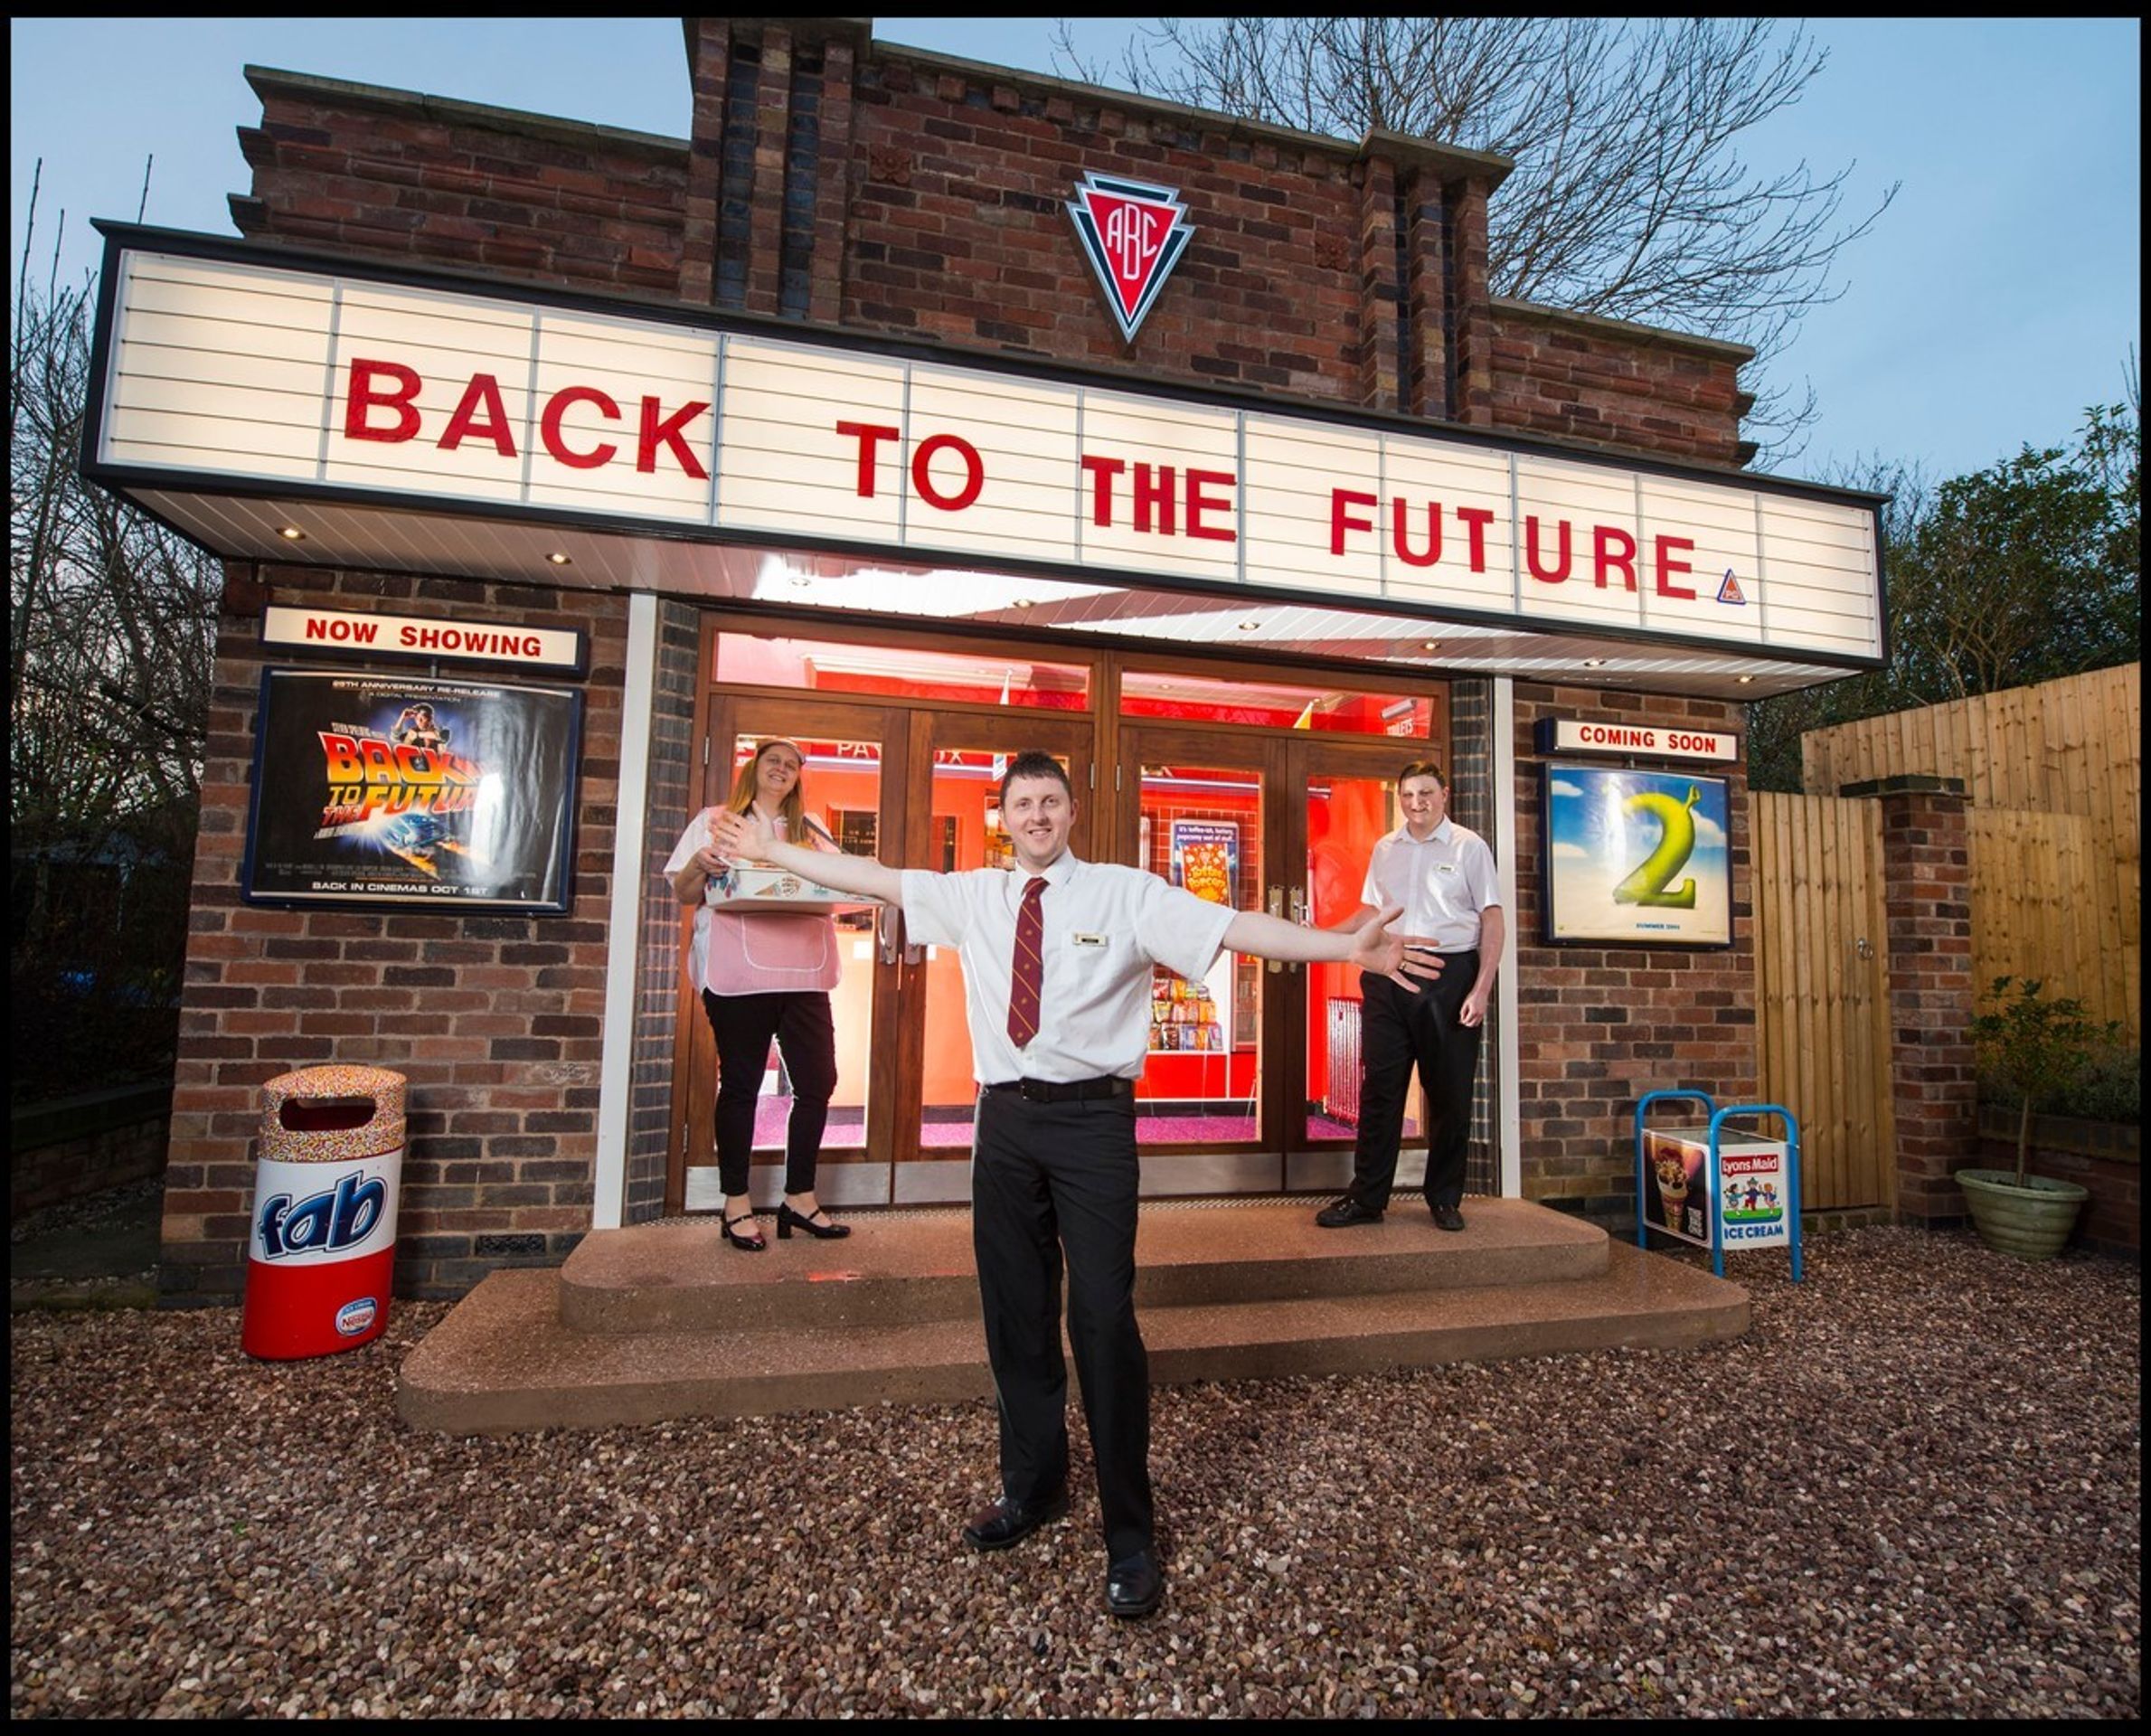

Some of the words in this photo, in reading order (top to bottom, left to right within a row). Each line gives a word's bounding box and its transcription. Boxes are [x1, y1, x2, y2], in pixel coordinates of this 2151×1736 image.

[1107, 203, 1158, 280] ABC
[344, 358, 711, 482] BACK
[835, 420, 985, 512] TO
[1081, 454, 1238, 542] THE
[1330, 488, 1696, 600] FUTURE
[306, 618, 378, 644] NOW
[400, 626, 542, 657] SHOWING
[1580, 726, 1655, 747] COMING
[1668, 734, 1716, 752] SOON
[318, 731, 486, 784] BACK
[329, 786, 361, 806] TO
[358, 785, 480, 819] FUTUR
[312, 882, 346, 891] BACK
[351, 882, 364, 892] IN
[367, 883, 428, 894] CINEMAS
[431, 886, 458, 894] OCT
[1722, 1160, 1750, 1175] Lyons
[1751, 1156, 1778, 1171] Maid
[259, 1171, 387, 1260] fab
[1724, 1227, 1744, 1240] ICE
[1746, 1224, 1783, 1238] CREAM
